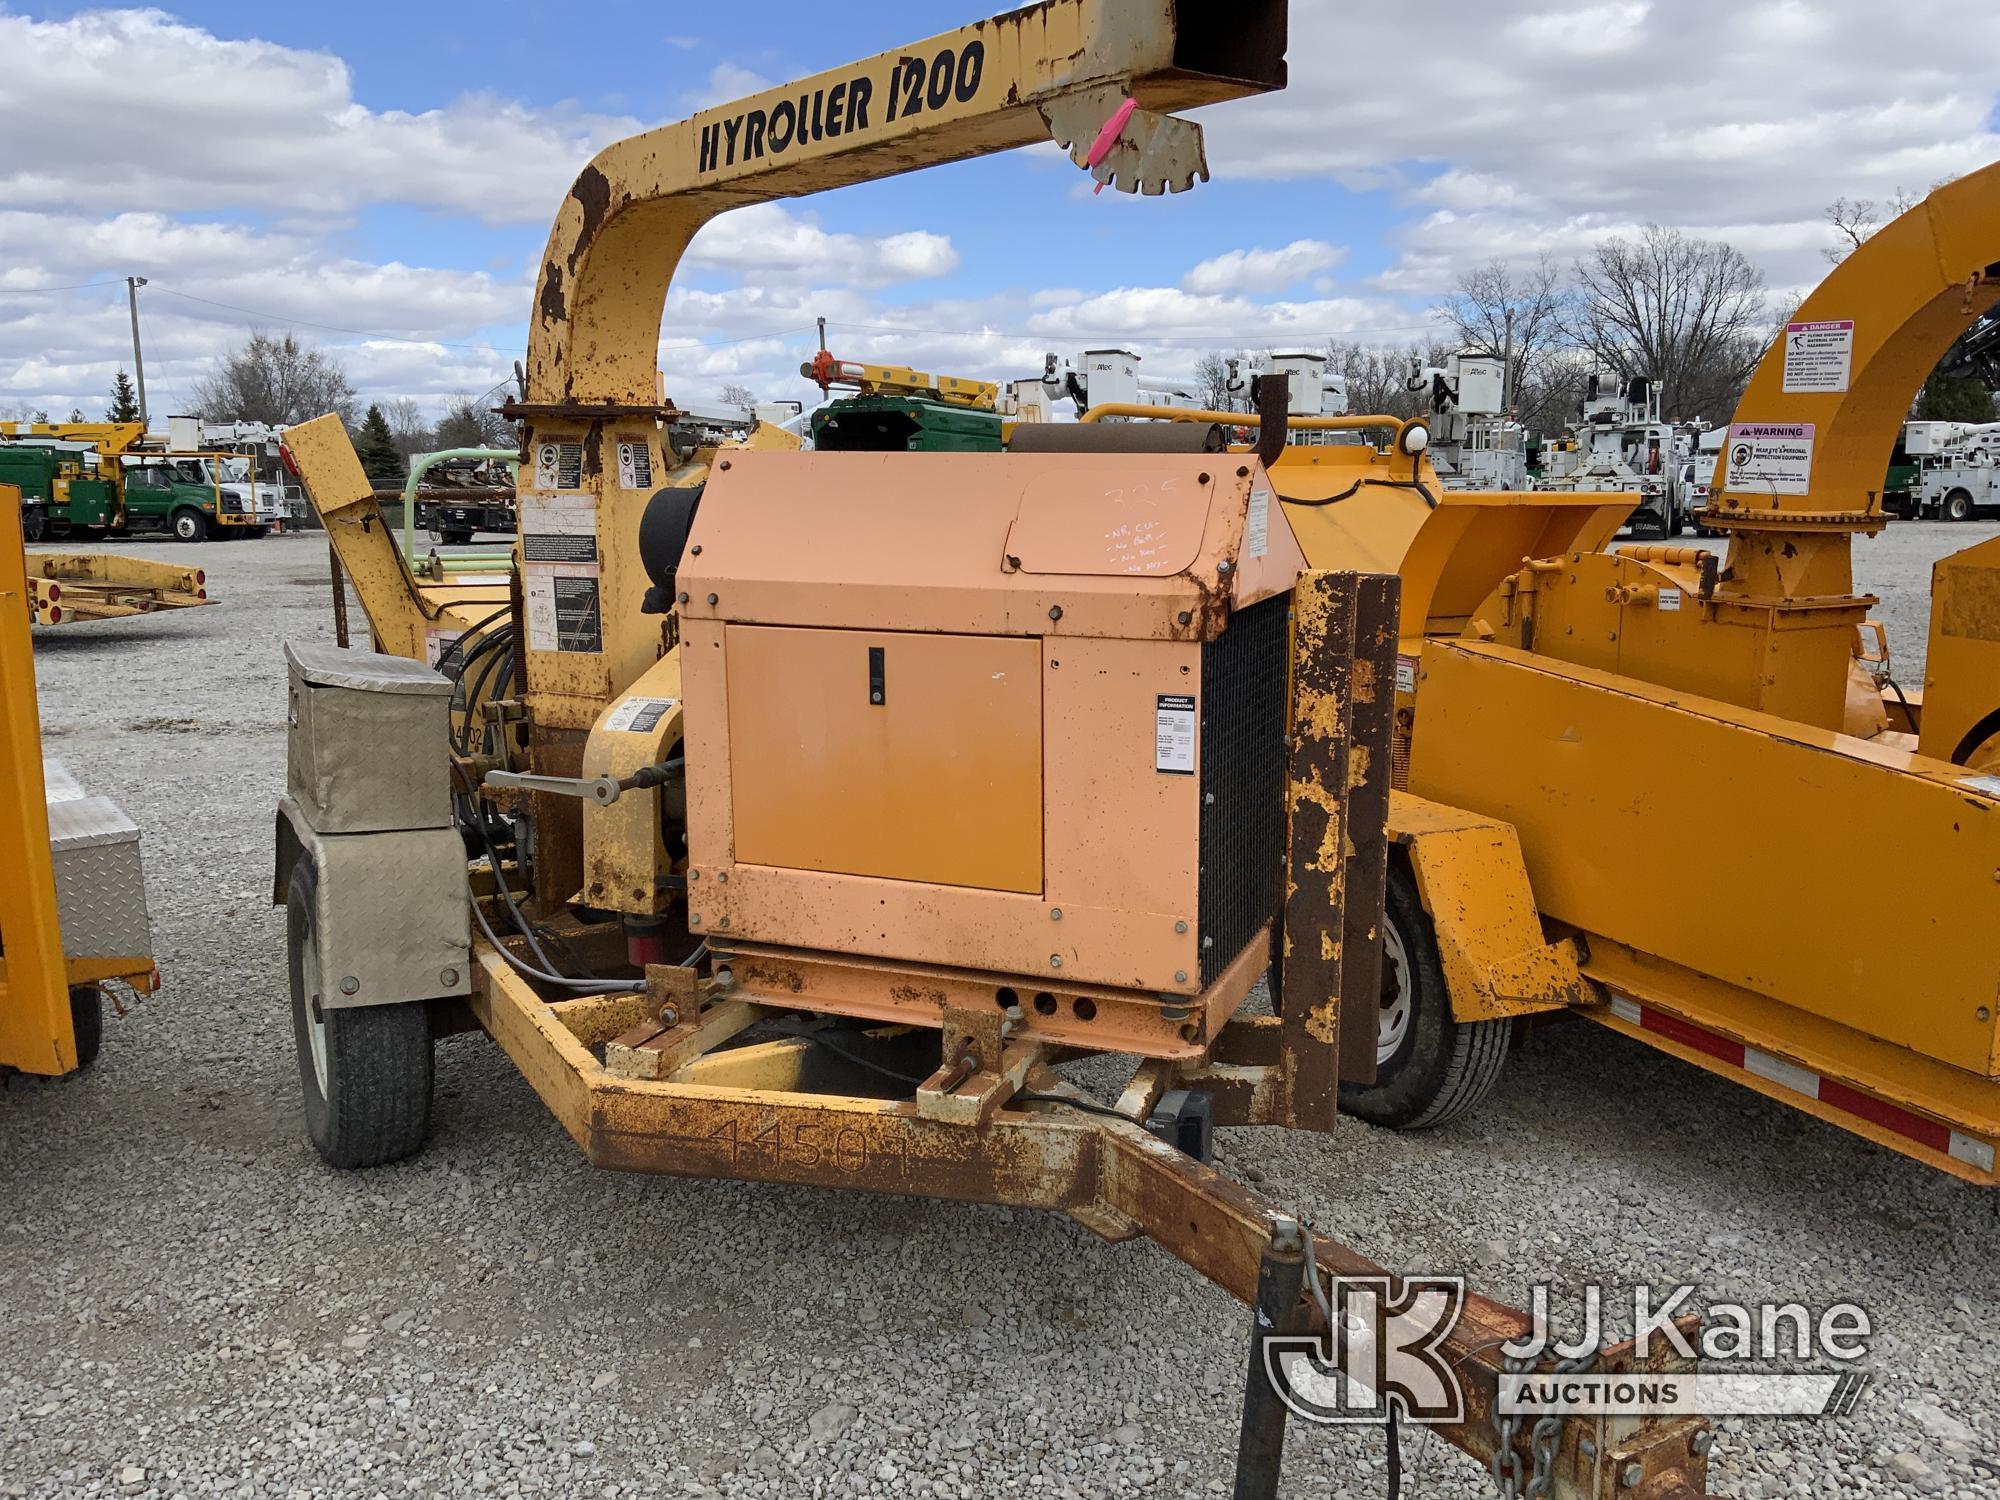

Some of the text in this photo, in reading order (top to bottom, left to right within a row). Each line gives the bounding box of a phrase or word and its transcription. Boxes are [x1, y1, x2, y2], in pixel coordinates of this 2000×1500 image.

[699, 40, 984, 173] HYROLLER 1200
[1753, 427, 1803, 436] WARNING
